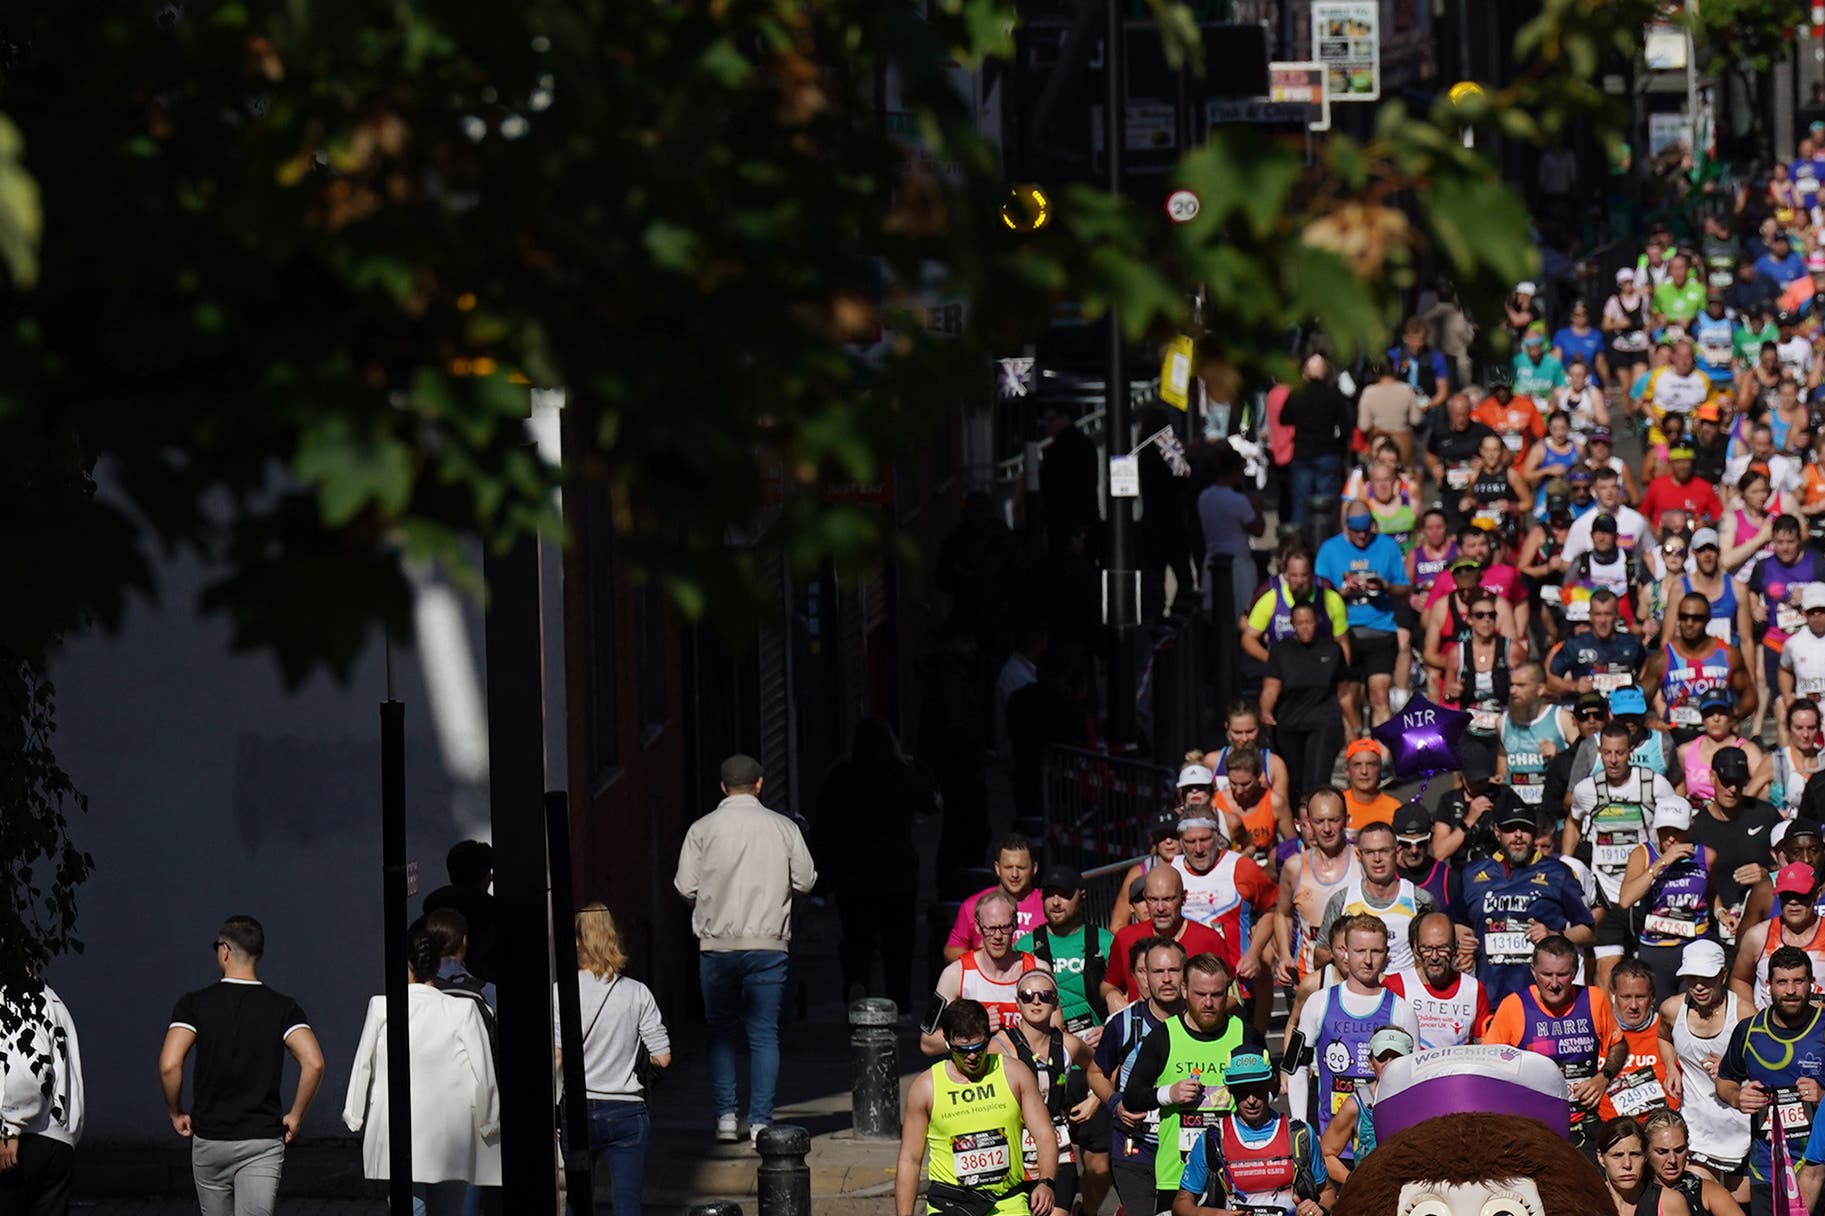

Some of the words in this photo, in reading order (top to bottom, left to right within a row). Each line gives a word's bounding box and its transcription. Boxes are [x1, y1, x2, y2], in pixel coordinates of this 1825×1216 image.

[1172, 200, 1197, 216] 20
[1403, 709, 1436, 729] NIR
[1412, 1000, 1471, 1016] STEVE
[1536, 1018, 1589, 1037] MARK
[1558, 1045, 1584, 1055] LUNG
[1585, 1044, 1594, 1053] UK
[947, 1083, 996, 1106] TOM
[941, 1106, 972, 1121] Havens
[971, 1101, 1007, 1116] Hospices
[960, 1150, 1004, 1171] 38612
